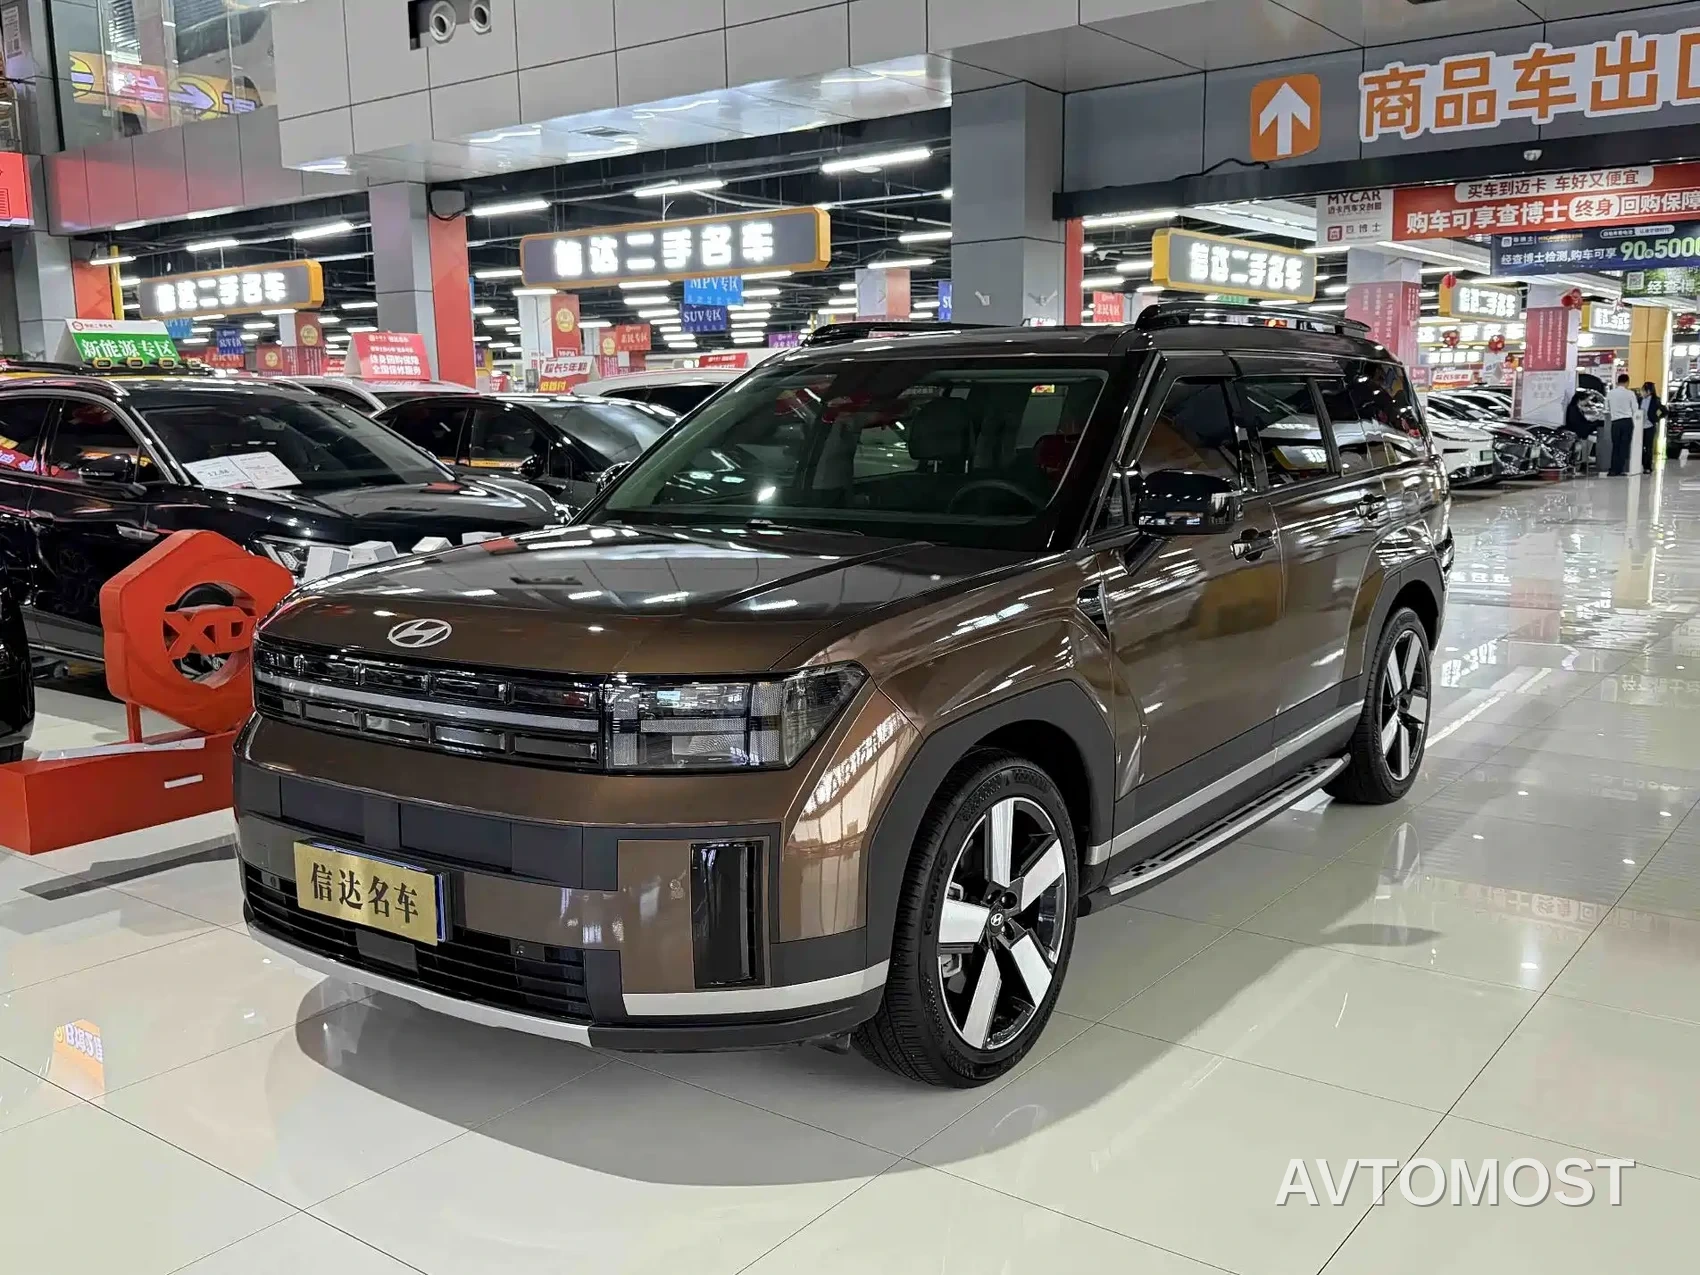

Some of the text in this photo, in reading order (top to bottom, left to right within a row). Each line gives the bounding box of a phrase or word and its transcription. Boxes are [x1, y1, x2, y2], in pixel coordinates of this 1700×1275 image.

[1467, 169, 1639, 199] 买车到迈卡 车好又便宜
[1327, 189, 1382, 205] MYCAR
[82, 338, 177, 359] 新能源专区
[310, 862, 419, 924] 信达名车
